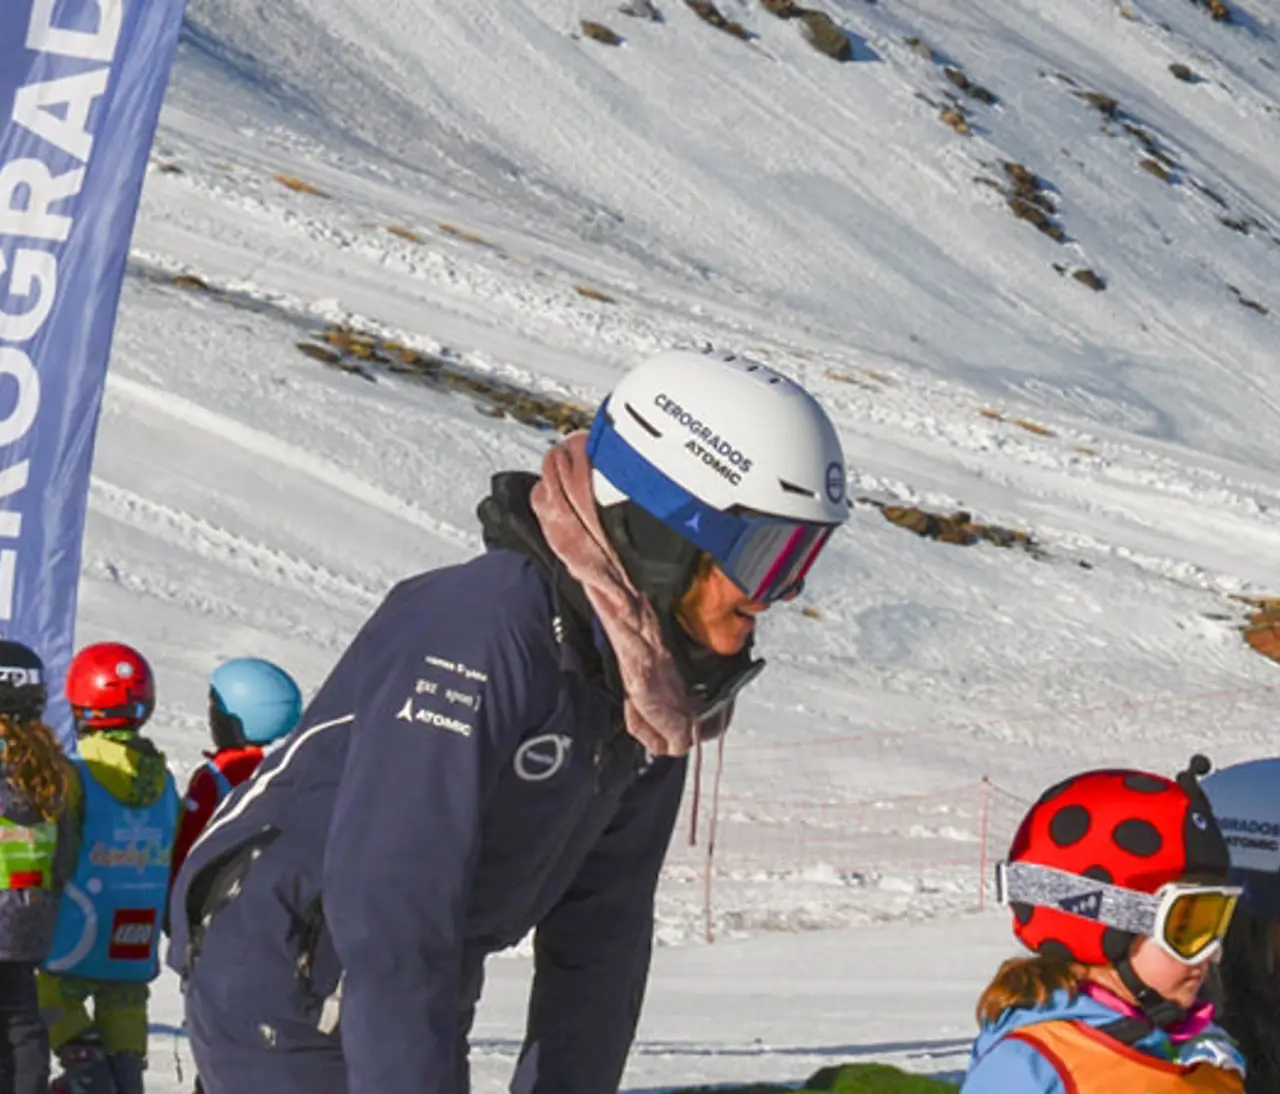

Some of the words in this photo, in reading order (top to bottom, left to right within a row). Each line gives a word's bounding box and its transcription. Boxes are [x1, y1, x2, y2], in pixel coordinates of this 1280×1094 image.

[654, 393, 754, 473] CEROGRADOS
[684, 439, 743, 487] ATOMIC
[416, 708, 472, 737] ATOMIC
